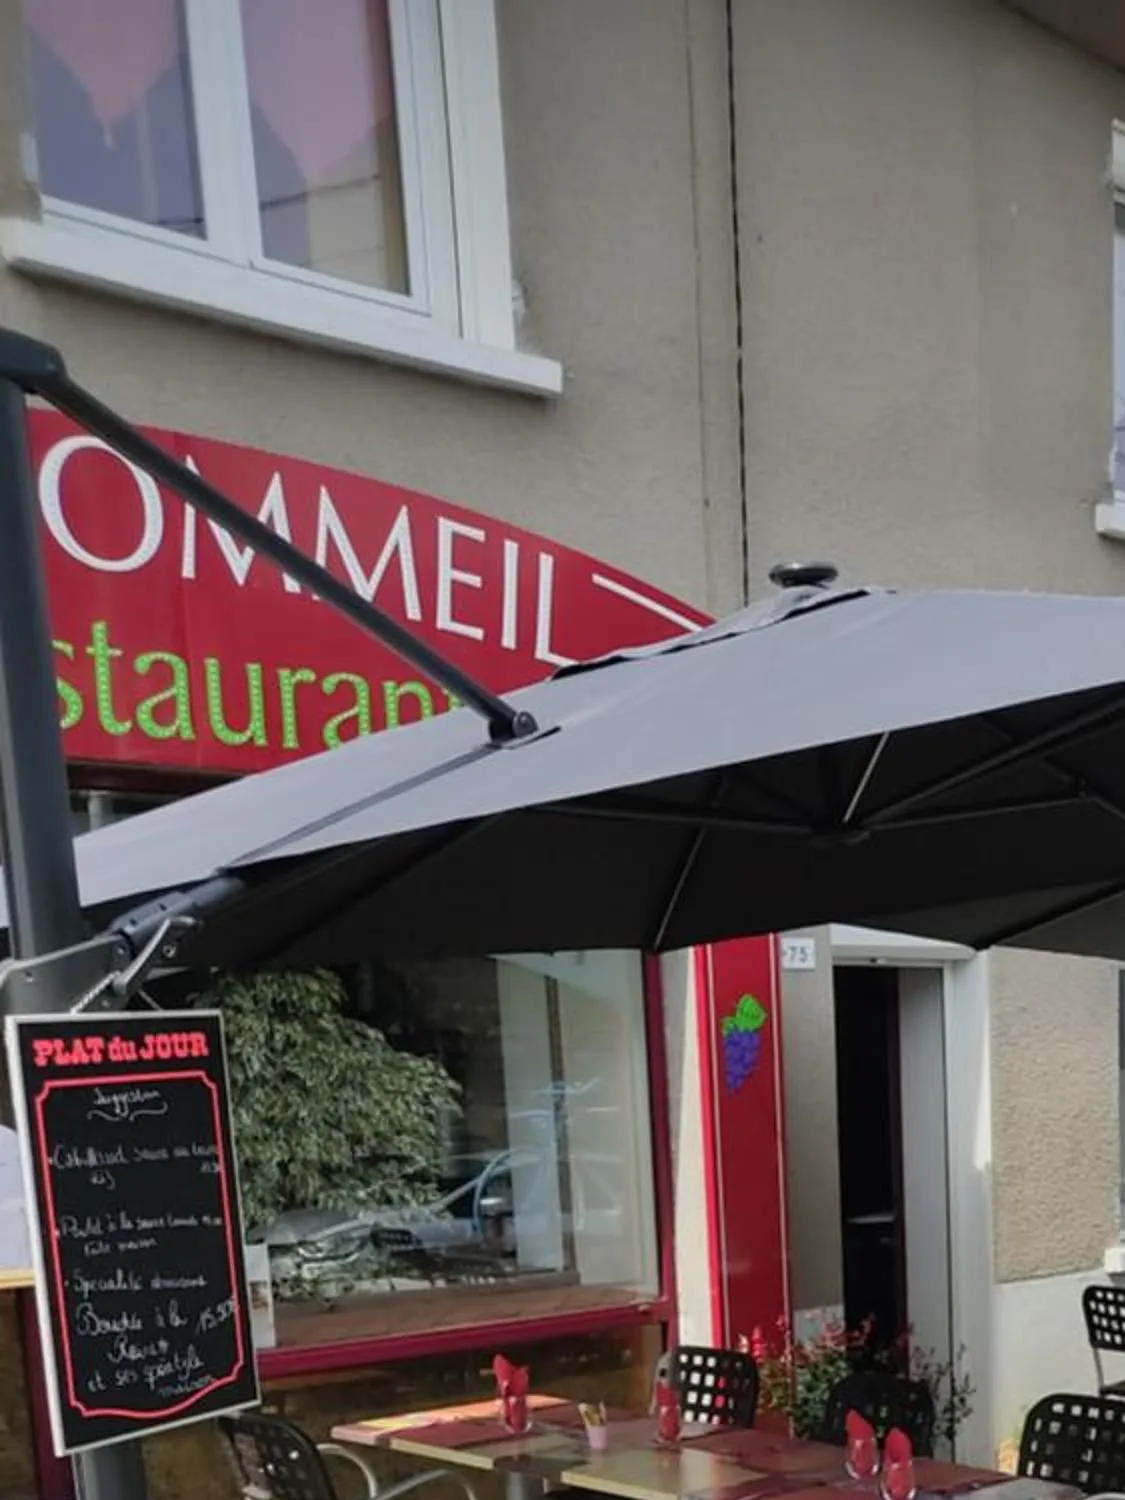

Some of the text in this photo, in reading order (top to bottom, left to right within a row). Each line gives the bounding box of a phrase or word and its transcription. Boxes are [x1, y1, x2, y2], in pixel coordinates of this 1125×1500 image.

[52, 620, 472, 751] stauran
[33, 1031, 210, 1067] PLAT du JOUR
